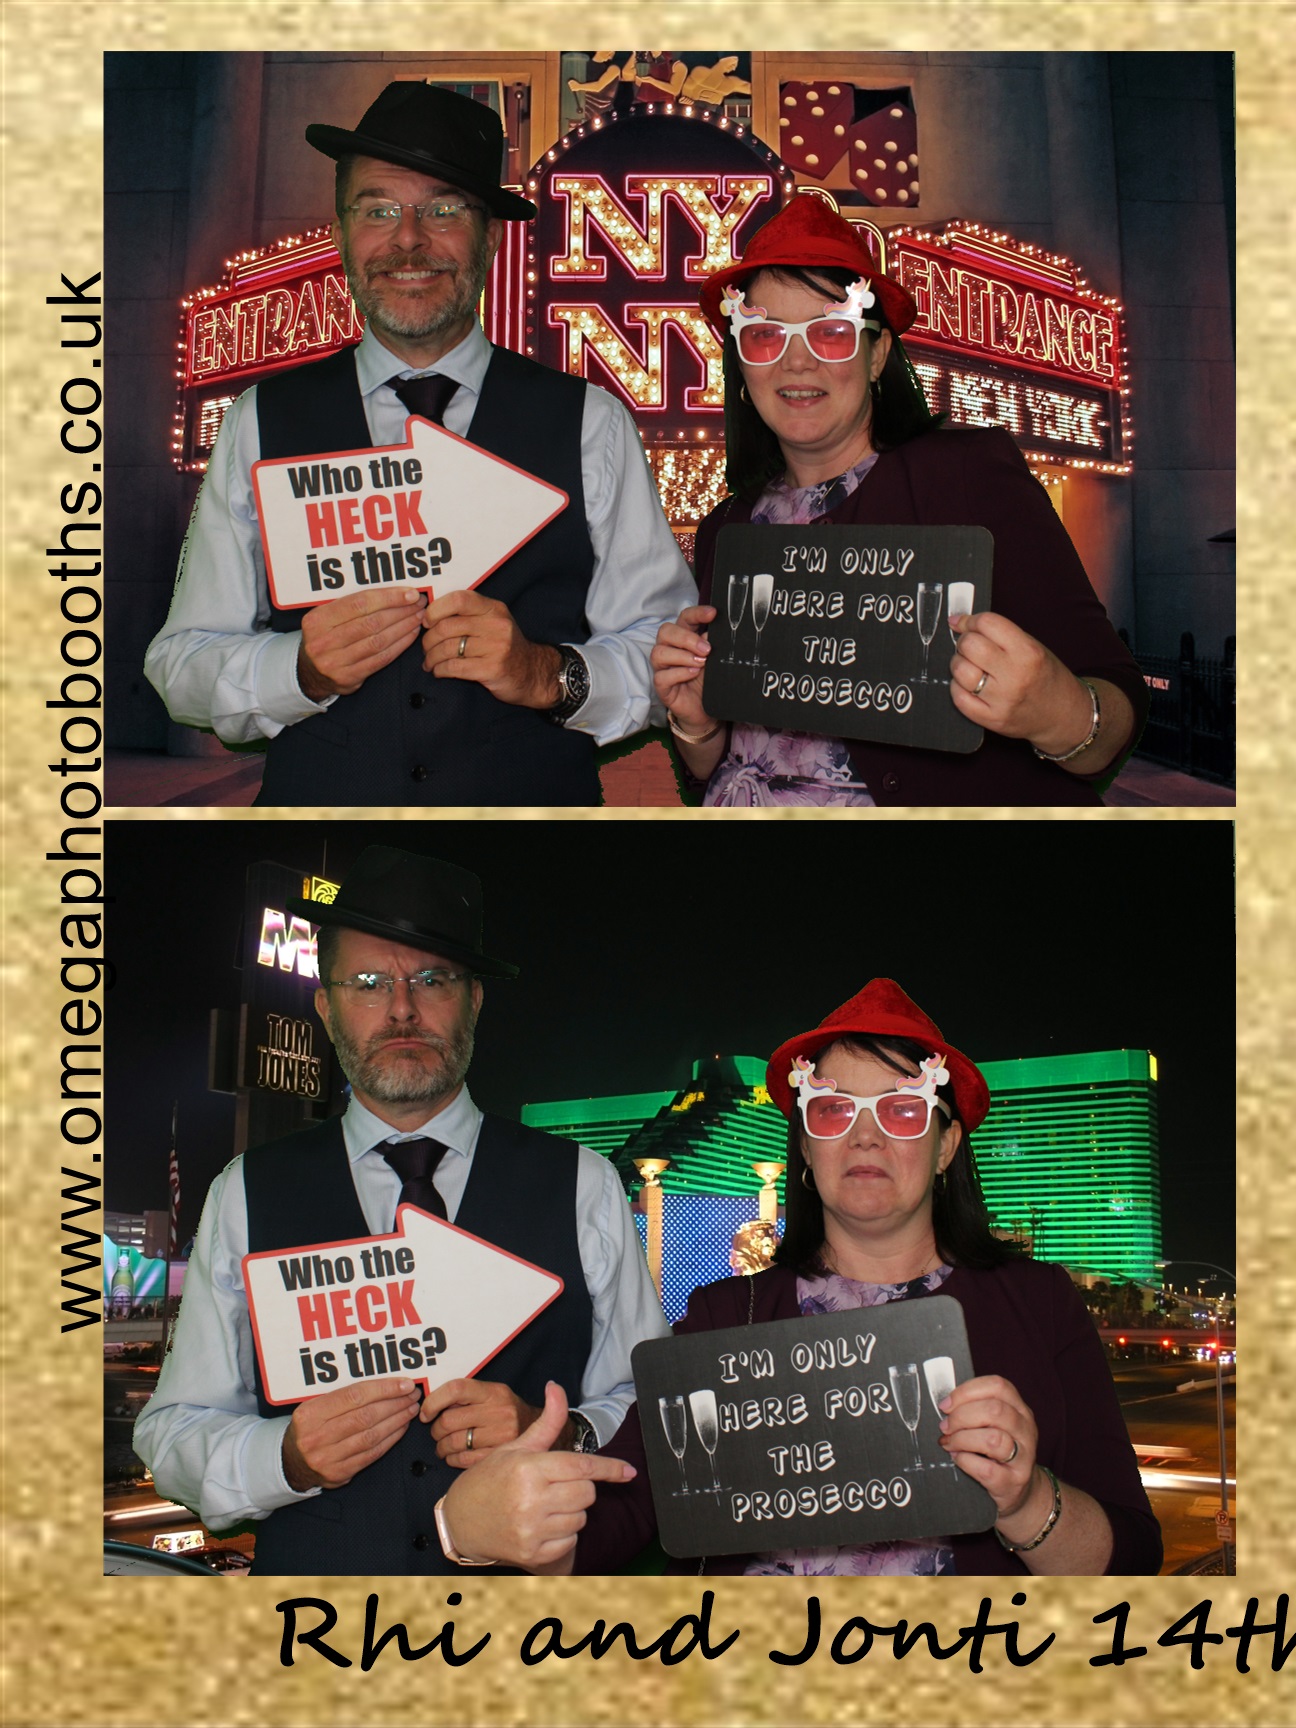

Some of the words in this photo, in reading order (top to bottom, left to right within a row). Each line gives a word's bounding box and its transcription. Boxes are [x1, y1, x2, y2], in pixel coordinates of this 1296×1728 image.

[550, 173, 772, 280] NY
[192, 274, 365, 374] ENTRAN
[900, 250, 1115, 378] ENTRANCE
[287, 463, 363, 499] Who
[368, 456, 423, 489] the
[305, 490, 428, 549] HECK
[306, 555, 345, 592] is
[350, 537, 452, 586] this?
[782, 545, 828, 573] I'M
[840, 547, 915, 576] ONLY
[771, 590, 844, 619] HERE
[857, 593, 914, 624] FOR
[802, 635, 856, 666] THE
[762, 670, 913, 714] PROSECCO
[267, 1013, 313, 1057] TOM
[257, 1051, 321, 1098] JONES
[277, 1254, 355, 1292] Who
[360, 1245, 415, 1279] the
[297, 1279, 422, 1342] HECK
[299, 1348, 339, 1386] is
[344, 1326, 447, 1378] this?
[718, 1348, 775, 1383] I'M
[790, 1332, 877, 1374] ONLY
[719, 1393, 809, 1432] HERE
[824, 1382, 892, 1420] FOR
[767, 1440, 836, 1476] THE
[731, 1476, 912, 1522] PROSECCO
